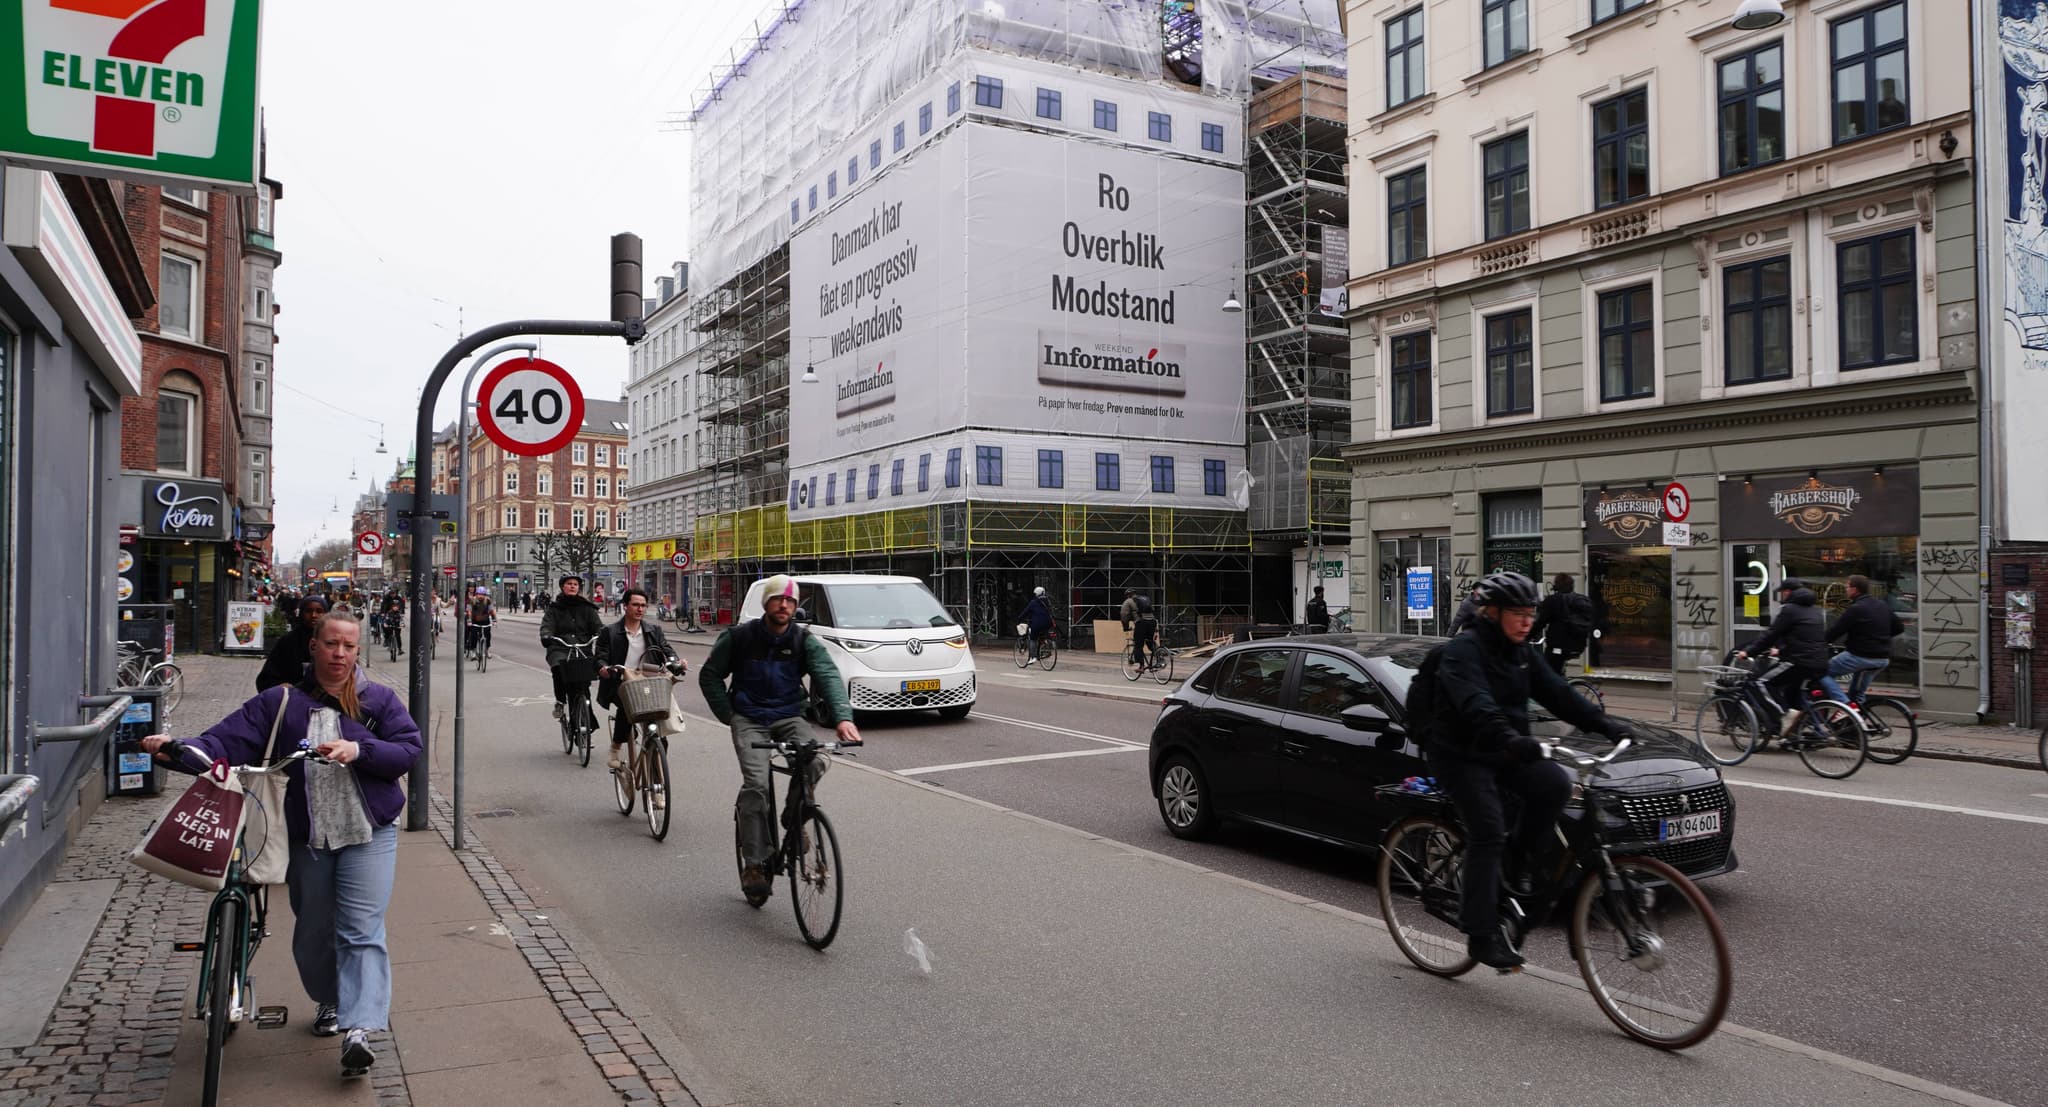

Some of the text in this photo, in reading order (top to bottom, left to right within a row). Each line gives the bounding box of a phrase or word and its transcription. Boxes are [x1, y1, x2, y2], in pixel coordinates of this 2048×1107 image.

[1098, 172, 1130, 212] Ro
[831, 200, 903, 267] Danmark har
[1062, 221, 1165, 270] Overblik
[820, 238, 918, 318] fået en progressiv
[1052, 274, 1175, 325] Modstand
[831, 297, 903, 359] weekendavis
[1094, 343, 1134, 354] WEEKEND
[496, 388, 563, 424] 40
[1038, 395, 1048, 408] På
[1048, 397, 1065, 411] papir
[1067, 399, 1082, 411] hver
[1107, 401, 1124, 414] Prøv
[1125, 405, 1134, 414] en
[1134, 405, 1158, 417] måned
[1158, 405, 1169, 417] for
[1175, 408, 1185, 419] kr.
[1598, 499, 1662, 522] BARBERSHOP
[1773, 488, 1854, 516] BARBERSHOP
[675, 555, 686, 565] 40
[214, 827, 231, 840] IN
[1668, 815, 1718, 837] DX 94 601
[178, 830, 215, 852] LATE
